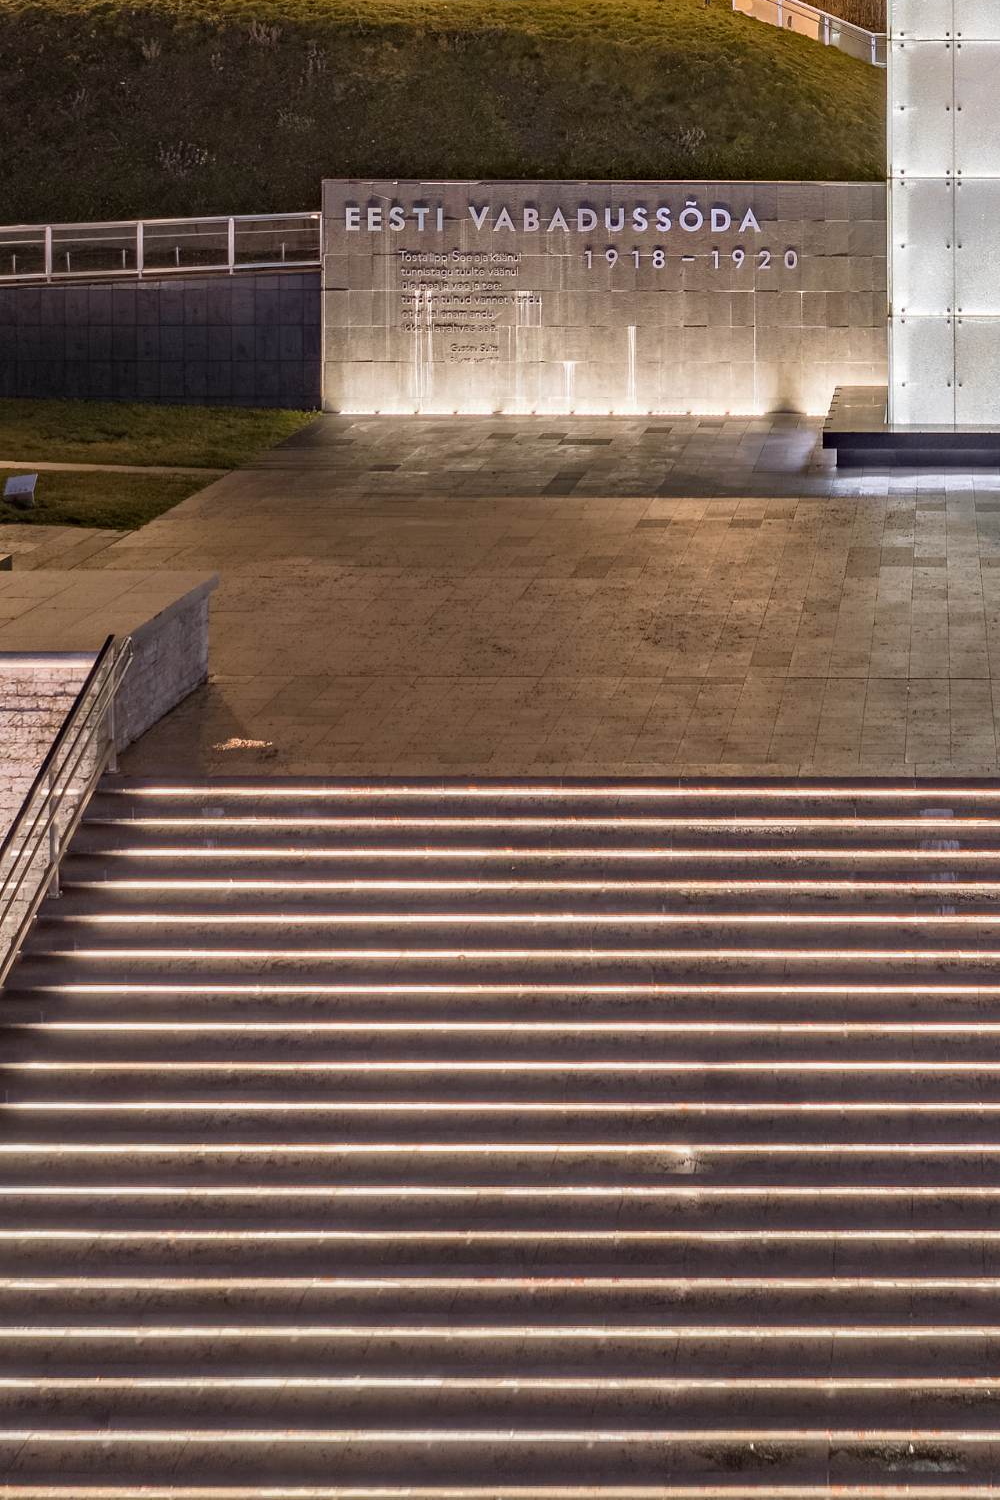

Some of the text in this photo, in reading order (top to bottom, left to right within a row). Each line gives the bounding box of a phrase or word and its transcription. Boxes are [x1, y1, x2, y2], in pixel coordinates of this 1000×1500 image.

[344, 199, 763, 233] EESTI VABADUSSÕDA
[583, 249, 667, 270] 1918
[711, 249, 798, 270] 1920
